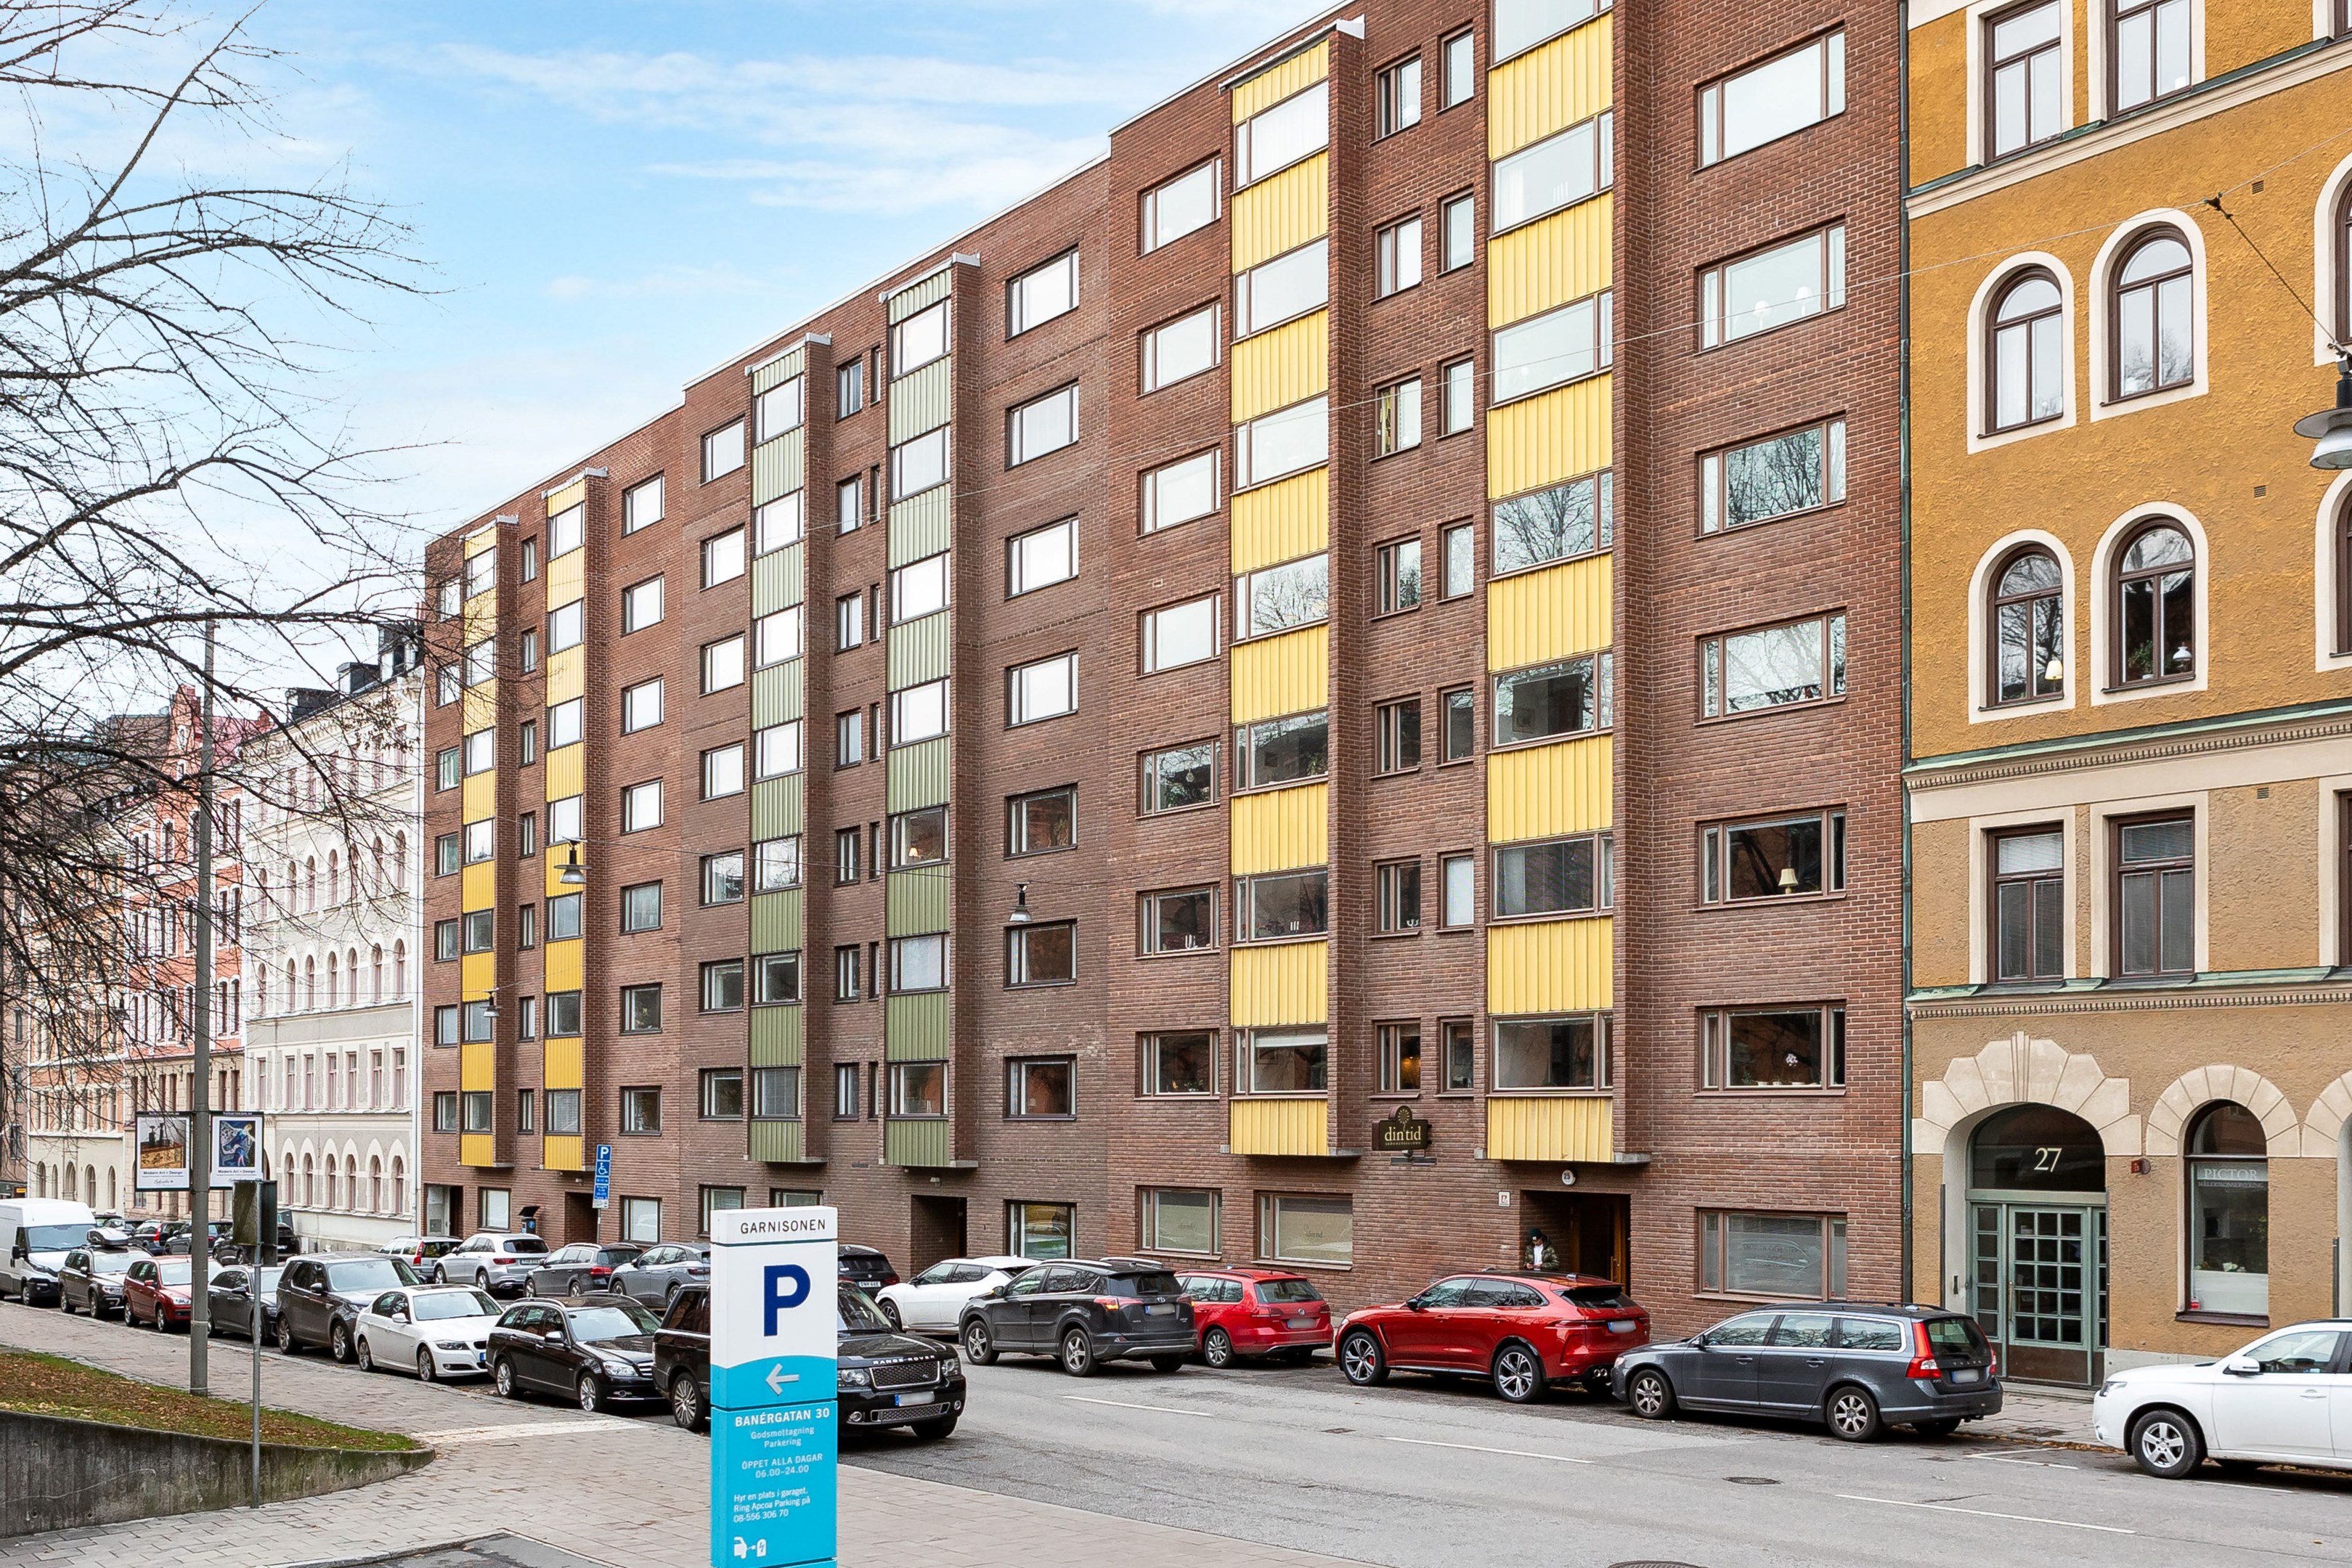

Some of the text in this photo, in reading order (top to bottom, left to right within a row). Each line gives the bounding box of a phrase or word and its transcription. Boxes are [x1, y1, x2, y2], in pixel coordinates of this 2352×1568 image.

[1384, 1126, 1421, 1141] din tid
[601, 1146, 609, 1159] P
[2033, 1148, 2062, 1173] 27
[2204, 1168, 2258, 1180] PICTOR
[741, 1218, 826, 1234] GARNISONEN
[763, 1264, 810, 1336] P
[735, 1408, 830, 1427] BANÉRGATAN 30
[751, 1426, 814, 1440] Godsmottagning
[764, 1438, 802, 1448] Parkering
[741, 1453, 823, 1470] ÖPPET ALLA DAGAR
[755, 1465, 809, 1478] 06.00-24.00
[733, 1494, 746, 1503] Hyr
[758, 1490, 775, 1501] plats
[733, 1495, 810, 1513] Ring Apcoa Parking på
[733, 1508, 789, 1523] 08-556 306 70
